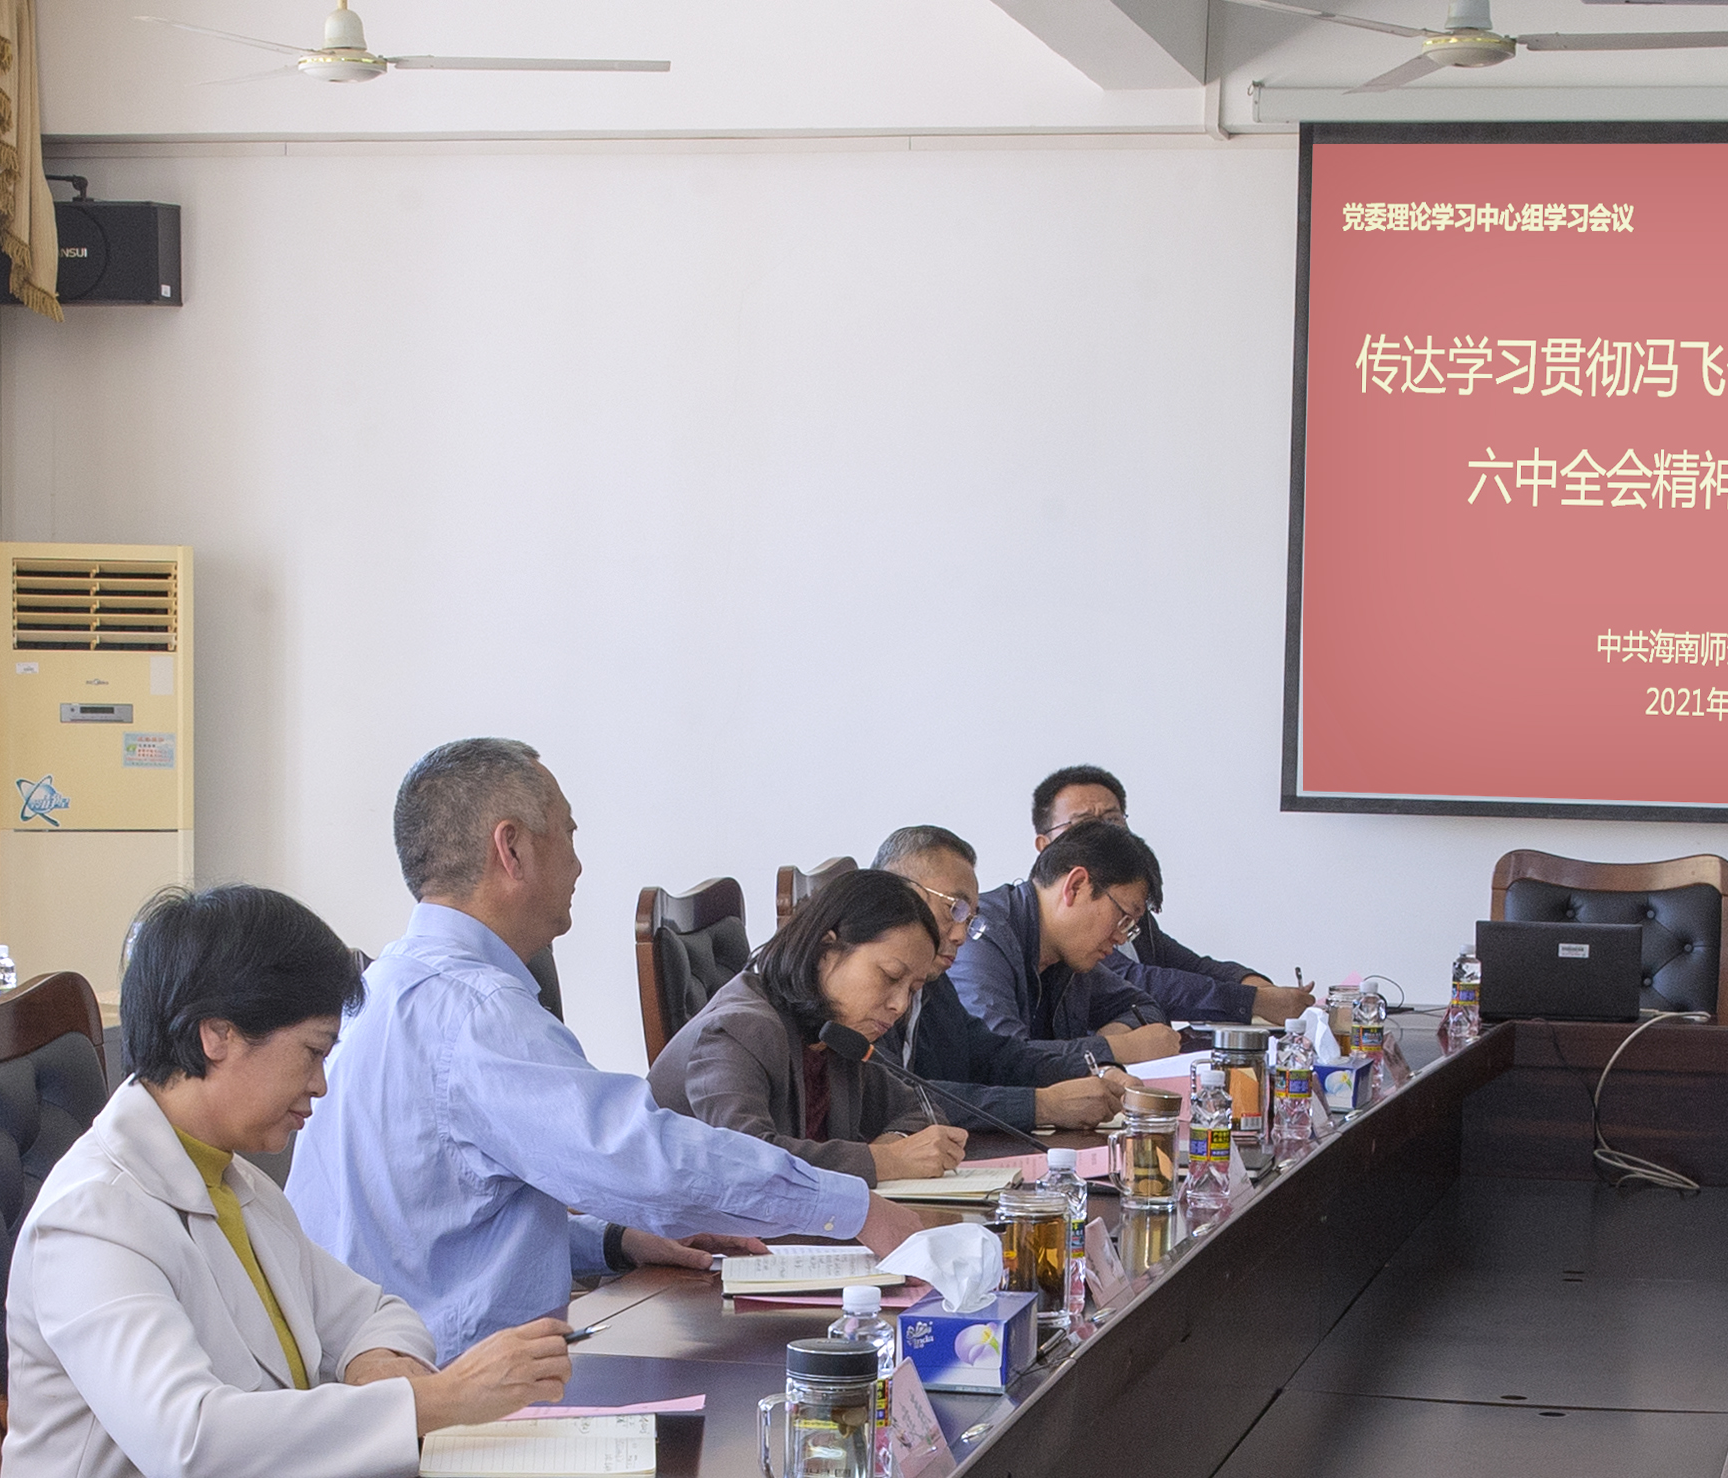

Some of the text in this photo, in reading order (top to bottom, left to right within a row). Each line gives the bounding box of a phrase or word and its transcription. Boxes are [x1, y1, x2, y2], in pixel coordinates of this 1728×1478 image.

[1341, 200, 1636, 234] 党委理论学习中心组学习会议
